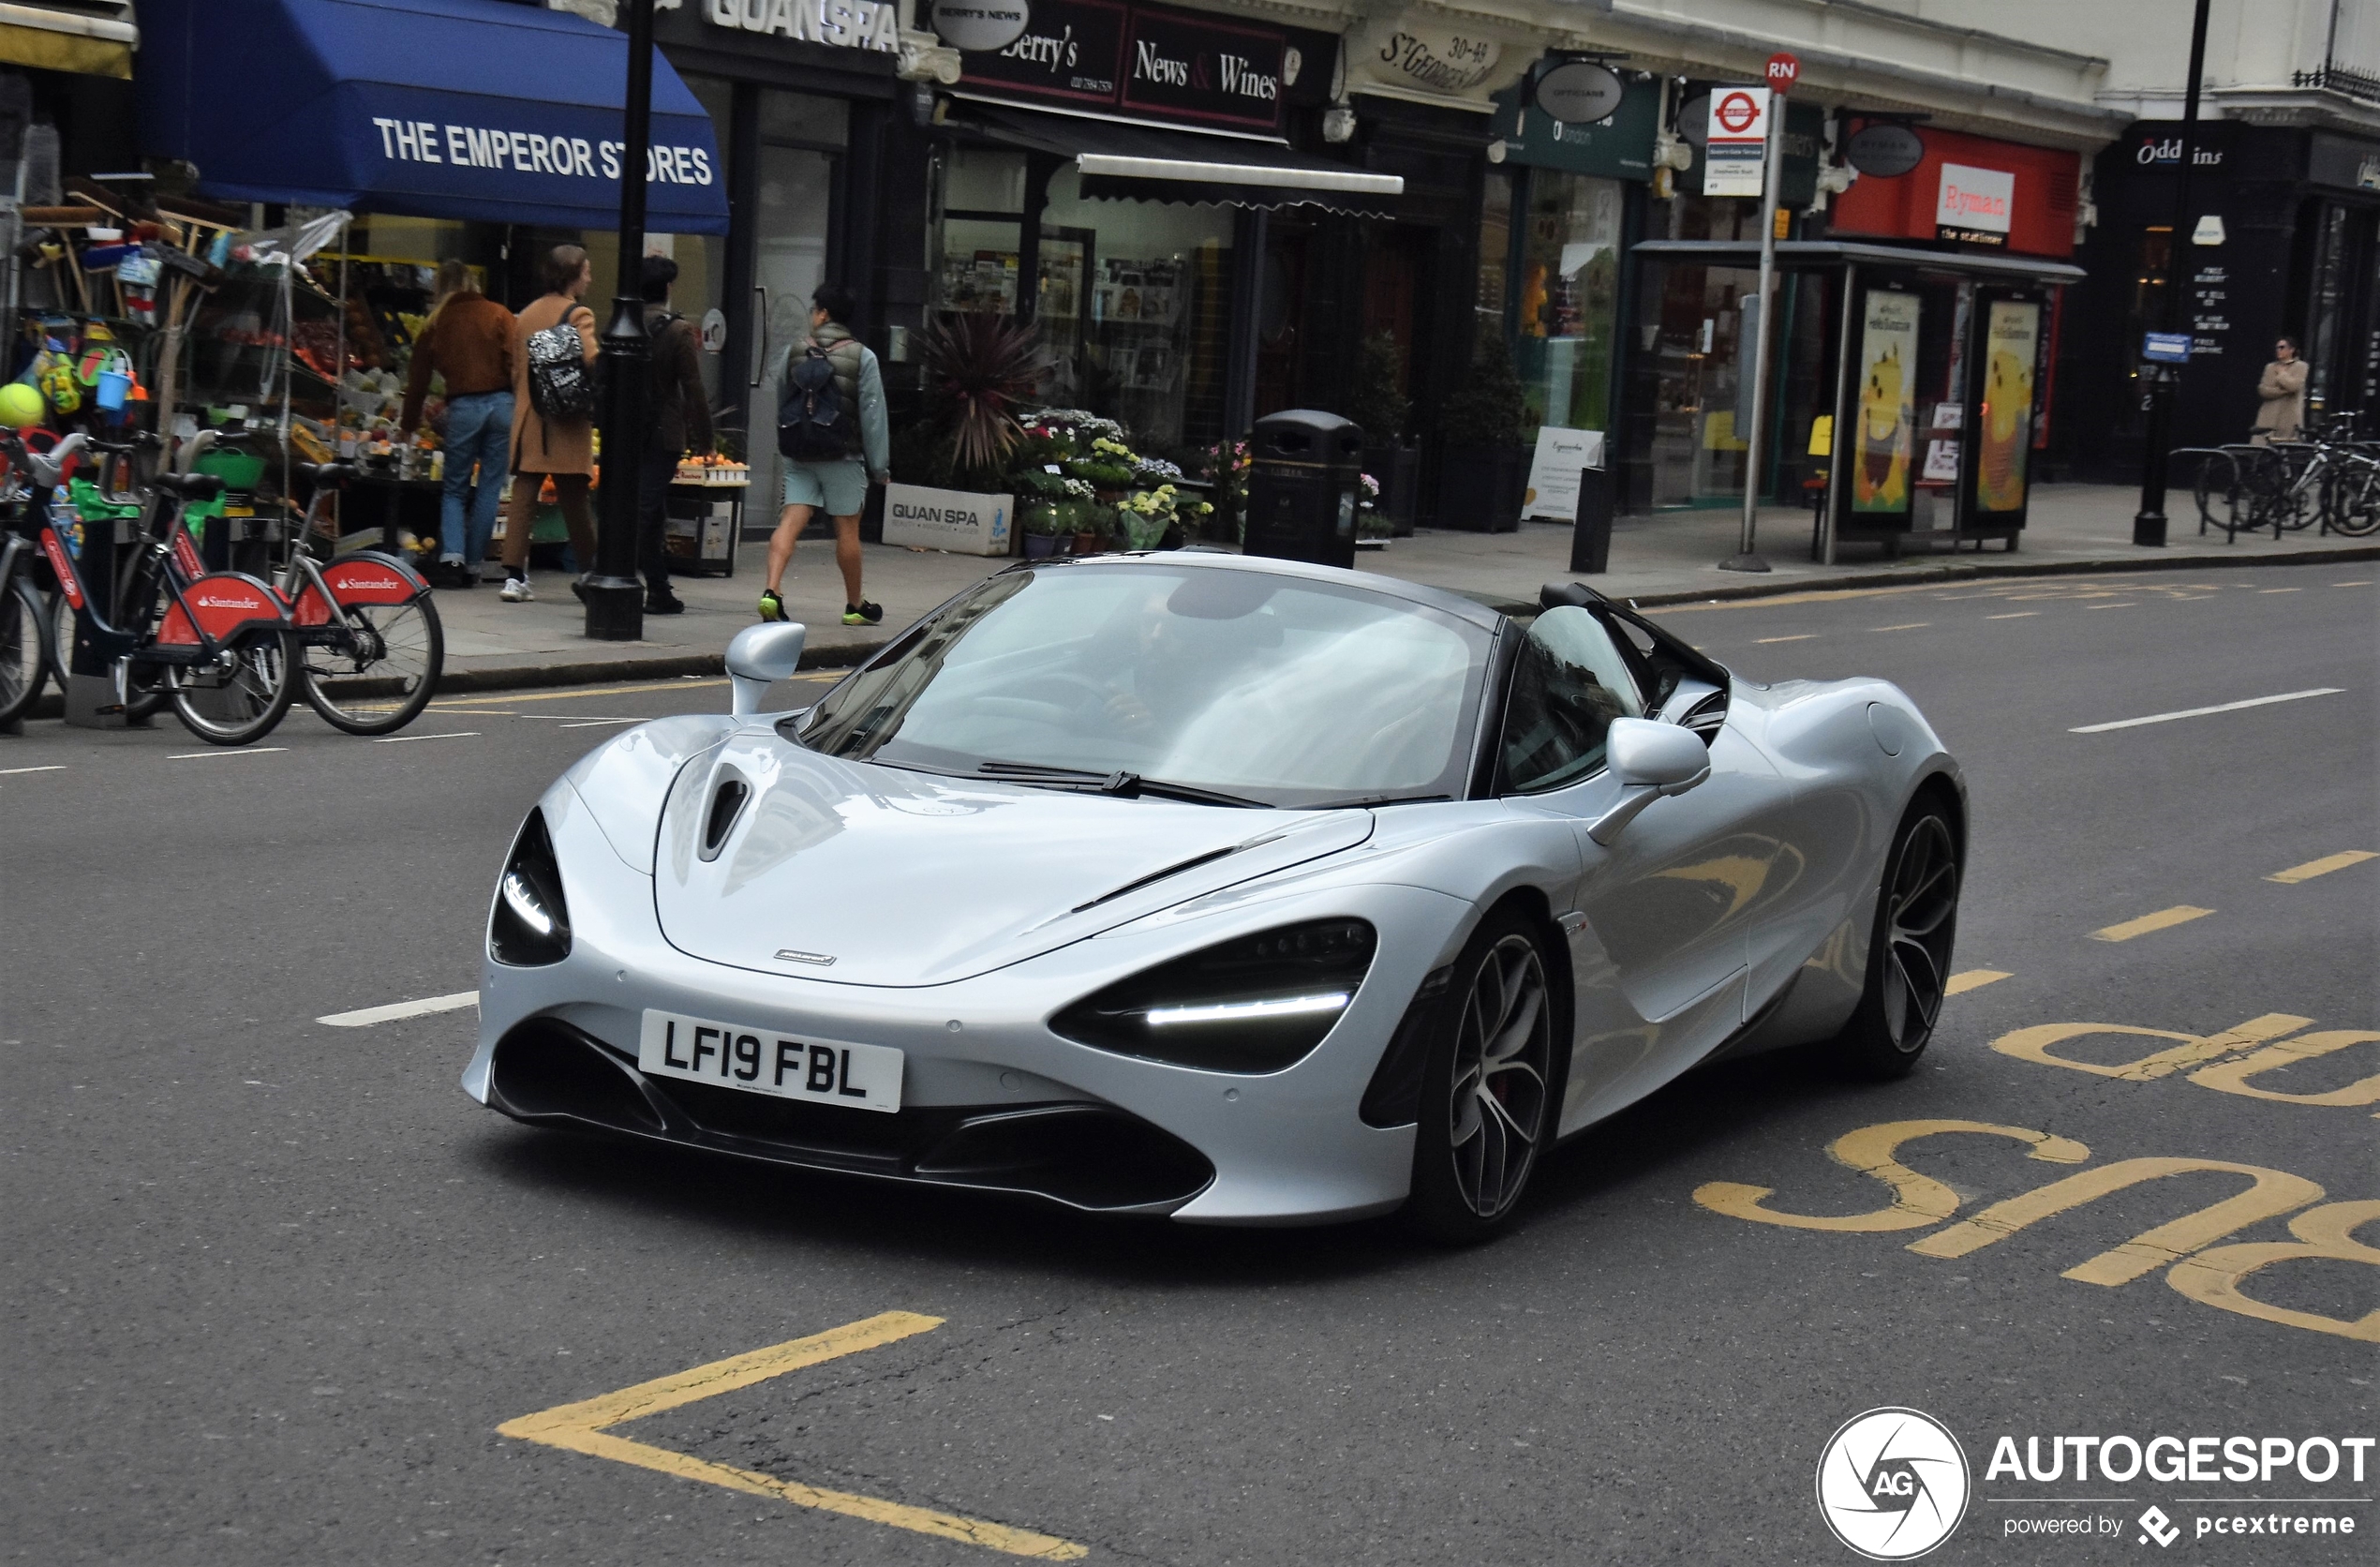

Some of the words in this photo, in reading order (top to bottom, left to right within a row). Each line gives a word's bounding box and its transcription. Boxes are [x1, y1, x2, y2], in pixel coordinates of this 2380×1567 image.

[709, 0, 822, 43] QUAN
[820, 0, 899, 54] SPA
[939, 7, 984, 19] BERRY'S
[987, 10, 1020, 22] NEWS
[1001, 25, 1078, 73] erry's
[1134, 40, 1188, 87] News
[1192, 52, 1212, 90] &
[1219, 53, 1276, 100] Wines
[1768, 62, 1795, 79] RN
[373, 117, 442, 164] THE
[445, 125, 596, 177] EMPEROR
[2137, 139, 2224, 164] Oddins
[1945, 185, 2005, 216] Ryman
[1941, 228, 1957, 240] the
[893, 503, 942, 522] QUAN
[945, 509, 979, 527] SPA
[348, 578, 398, 590] Santander
[208, 596, 260, 609] Santander
[664, 1021, 761, 1082] LF19
[774, 1040, 867, 1098] FBL
